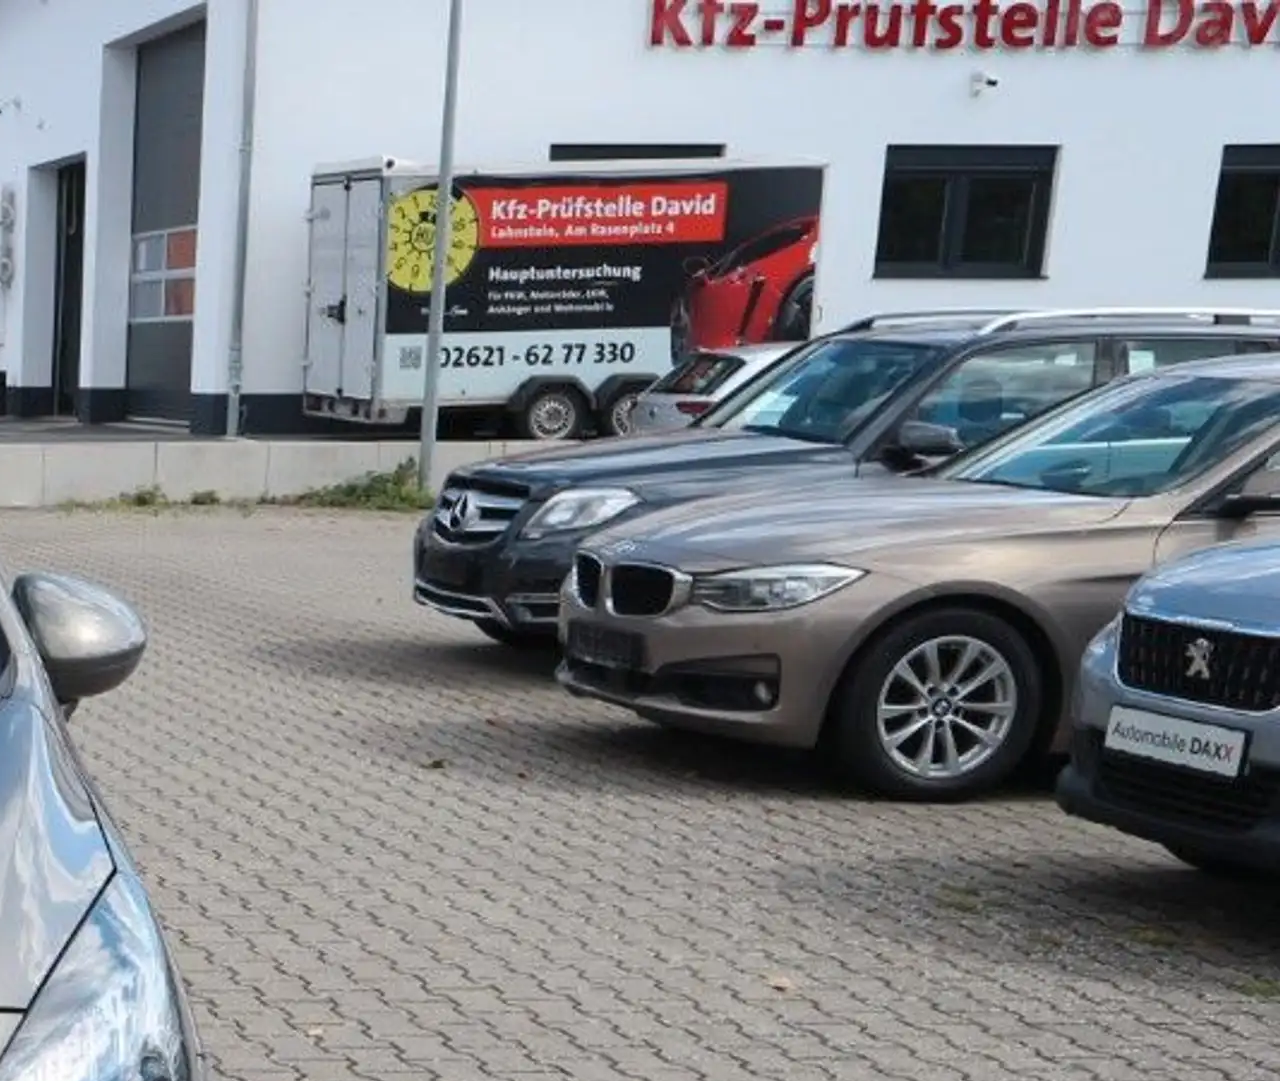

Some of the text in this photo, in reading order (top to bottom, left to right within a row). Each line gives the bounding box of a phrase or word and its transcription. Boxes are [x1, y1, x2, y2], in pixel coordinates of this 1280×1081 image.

[491, 192, 716, 221] Kfz-Prüfstelle David
[564, 224, 587, 236] Am
[666, 221, 675, 234] 4
[489, 264, 642, 284] Hauptuntersuchung
[525, 344, 554, 366] 62
[561, 343, 587, 364] 77
[593, 342, 636, 364] 330
[1112, 722, 1234, 763] Automobile DAXX
